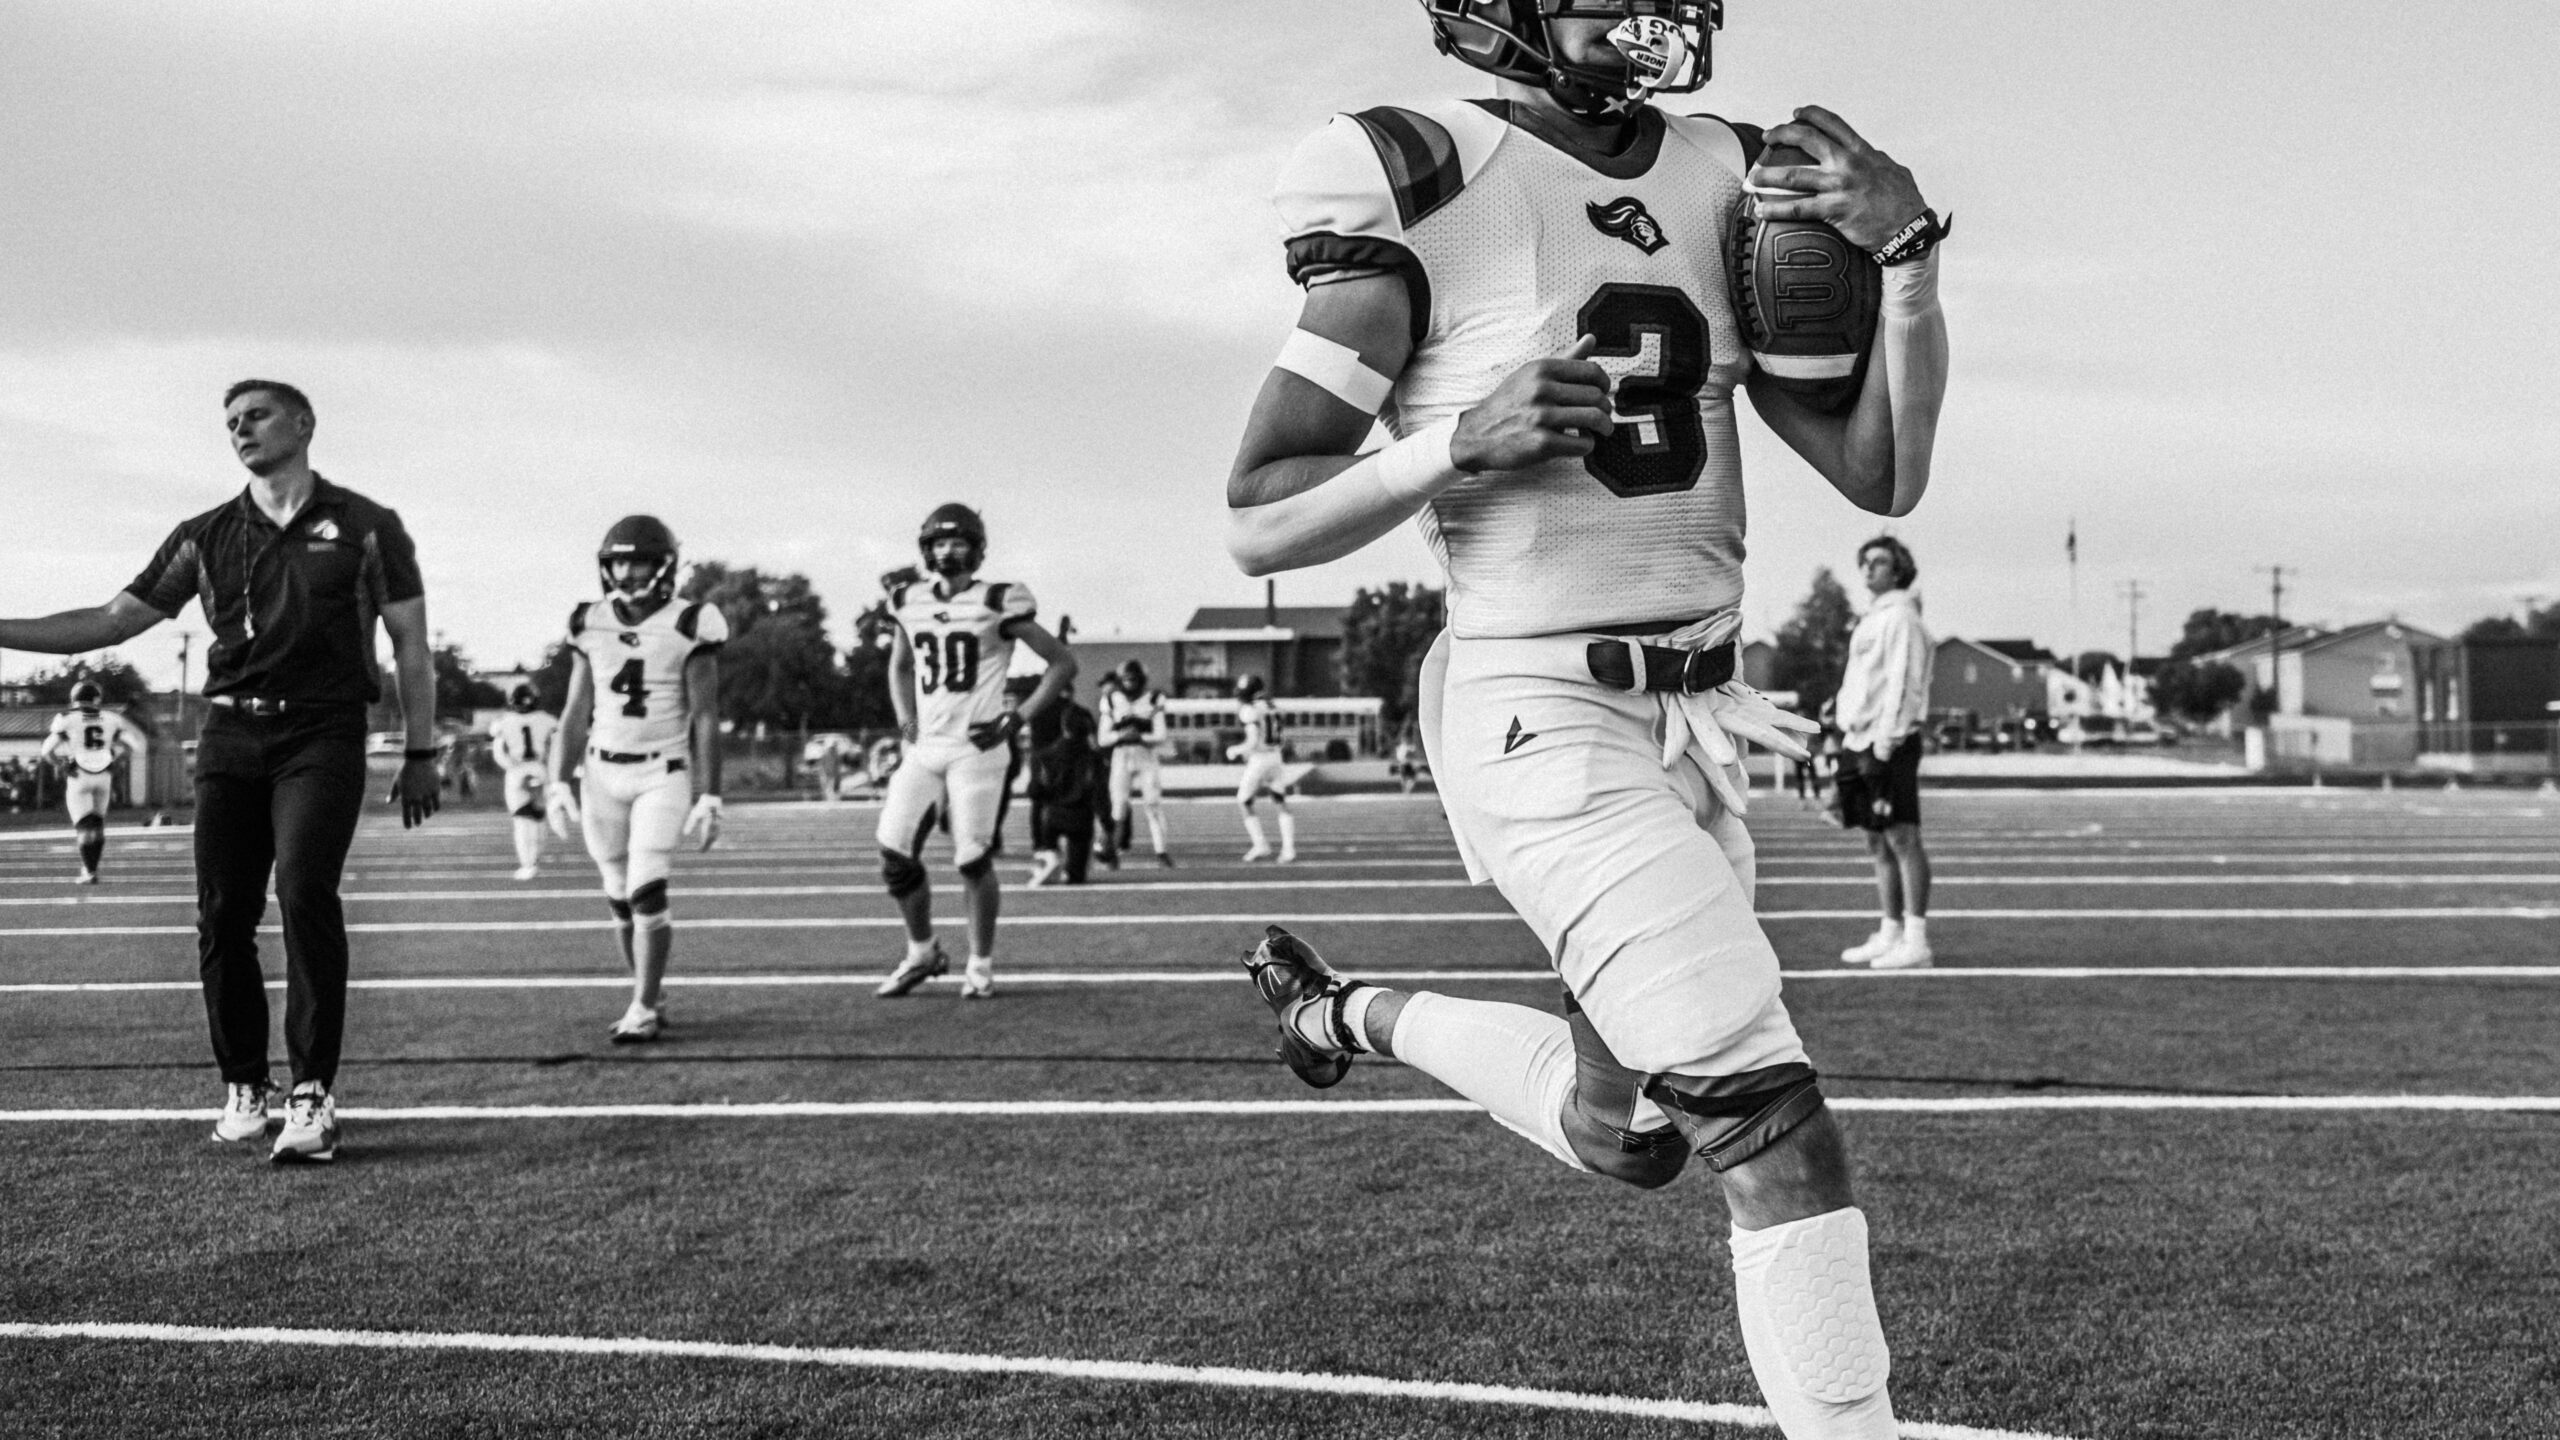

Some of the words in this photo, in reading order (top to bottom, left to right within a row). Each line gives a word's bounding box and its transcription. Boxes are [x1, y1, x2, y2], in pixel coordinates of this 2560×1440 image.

[1881, 215, 1928, 257] PHILIPPIANS
[1577, 282, 1712, 498] 3
[610, 658, 651, 718] 4
[914, 631, 980, 695] 30
[84, 725, 105, 751] 6
[521, 725, 539, 762] 1
